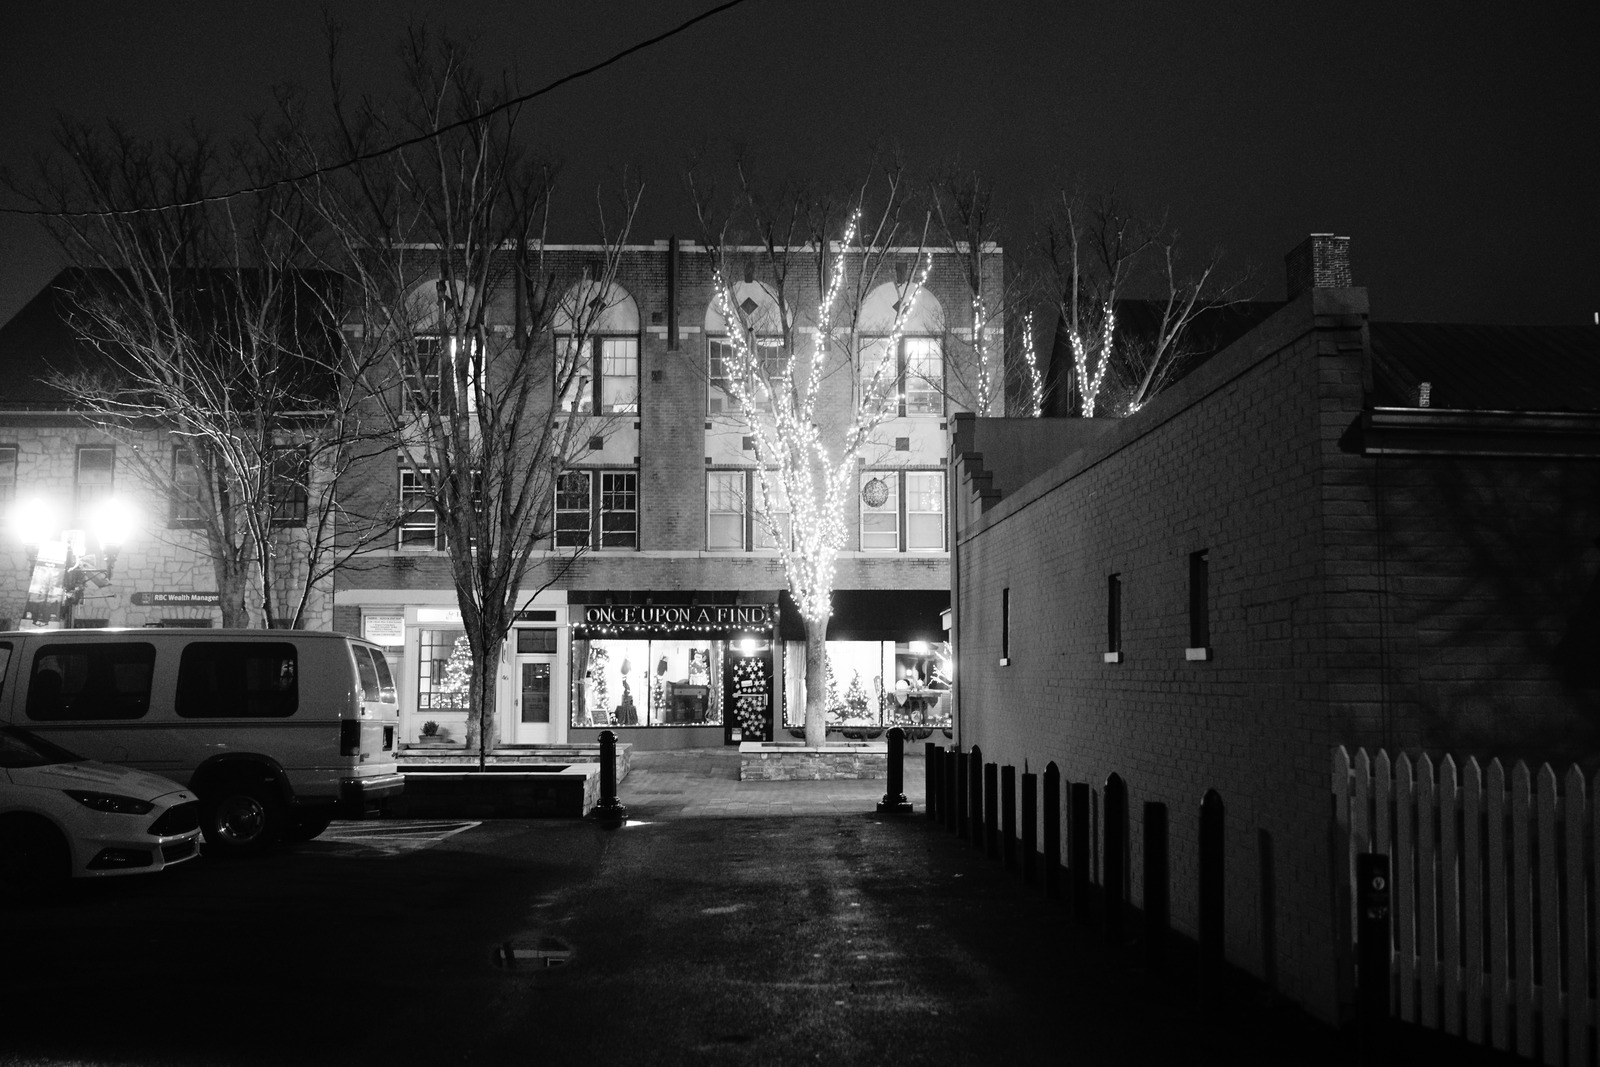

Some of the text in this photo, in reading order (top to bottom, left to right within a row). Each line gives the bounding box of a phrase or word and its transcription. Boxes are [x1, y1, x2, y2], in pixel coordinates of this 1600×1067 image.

[586, 607, 765, 623] ONCE UPON A FIND
